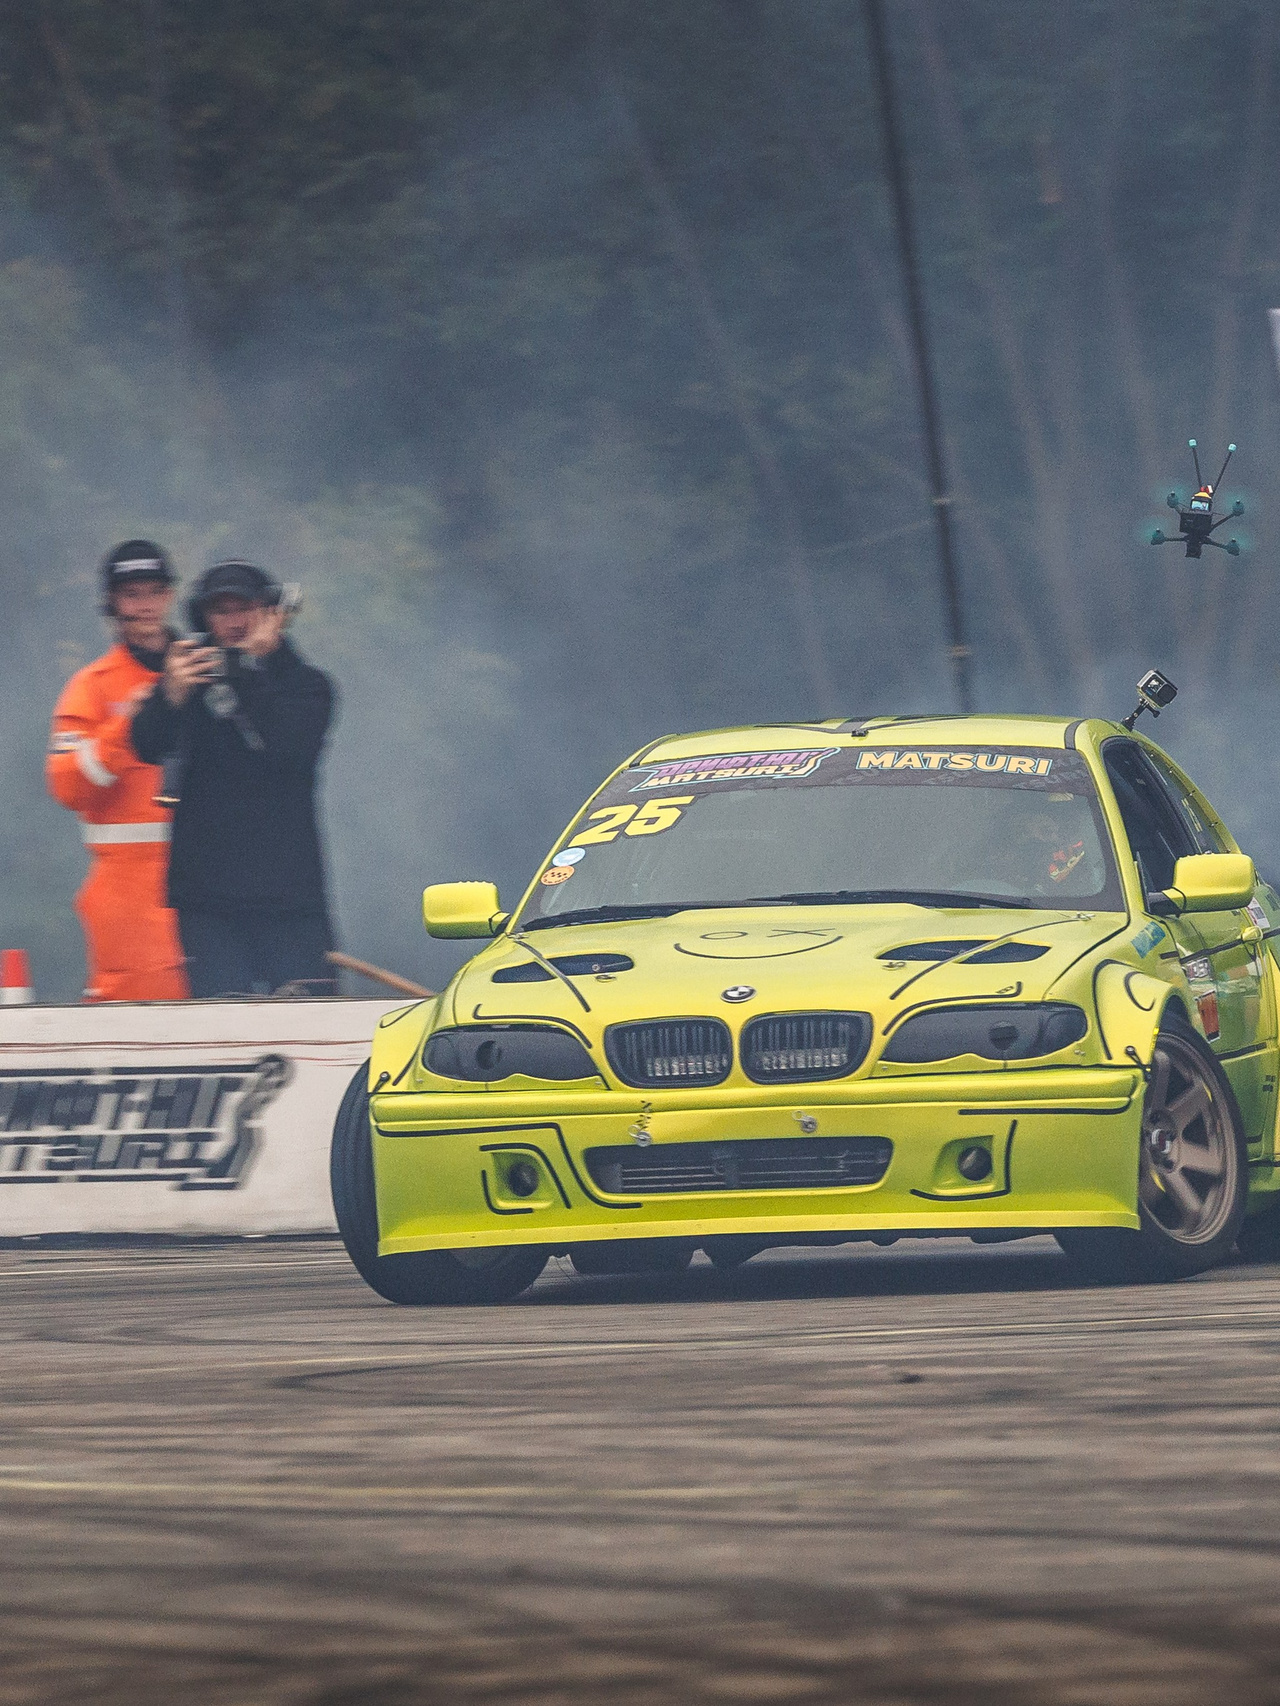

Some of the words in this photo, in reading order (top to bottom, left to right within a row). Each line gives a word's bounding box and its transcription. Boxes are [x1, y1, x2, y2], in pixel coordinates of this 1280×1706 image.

[641, 763, 812, 788] MATSURI
[858, 751, 1052, 776] MATSURI
[567, 795, 695, 848] 25
